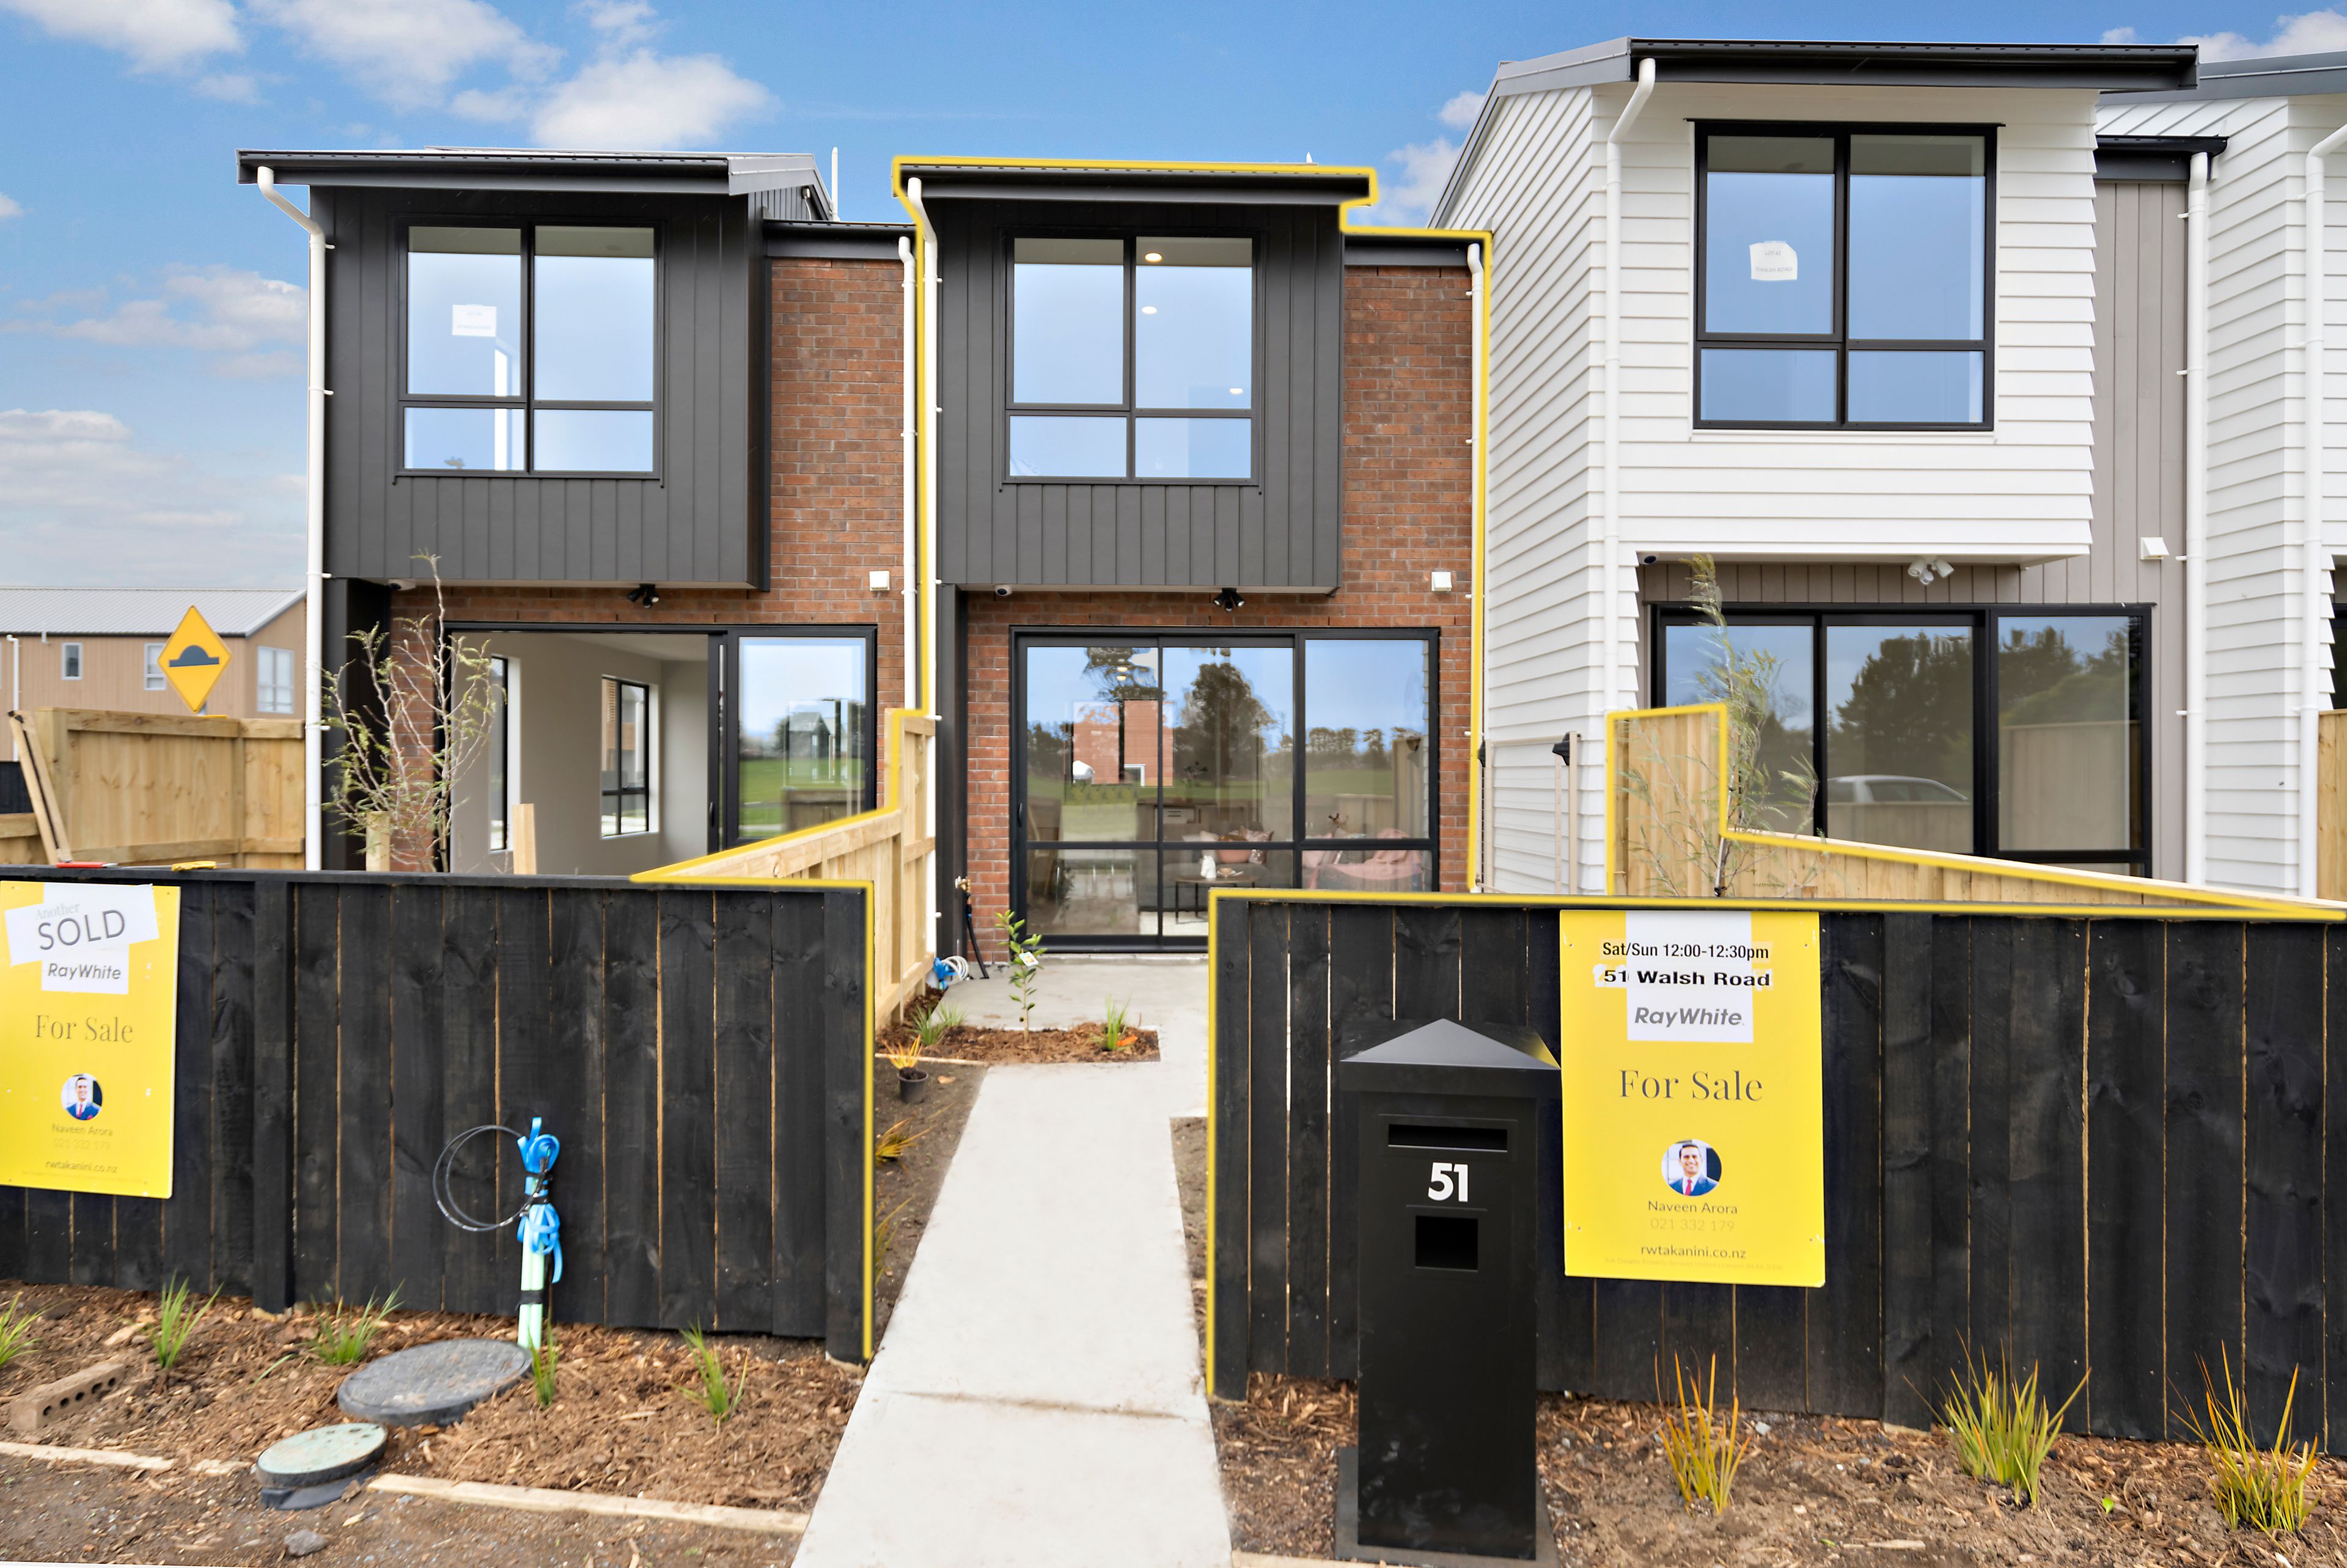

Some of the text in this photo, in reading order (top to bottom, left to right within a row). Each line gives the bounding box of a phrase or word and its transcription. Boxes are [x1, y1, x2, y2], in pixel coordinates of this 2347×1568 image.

[35, 902, 81, 920] Another
[38, 909, 126, 951] SOLD
[1603, 942, 1769, 961] Sat/Sun 12:00-12:30pm
[48, 963, 122, 980] RayWhite
[1603, 969, 1771, 986] 51 Walsh Road
[35, 1014, 134, 1044] For Sale
[1618, 1069, 1763, 1101] For Sale
[1427, 1162, 1469, 1203] 51
[1648, 1200, 1738, 1214] Naveen Arora
[1650, 1218, 1735, 1232] 021 332 179
[1641, 1245, 1747, 1259] rwtakanini.co.nz
